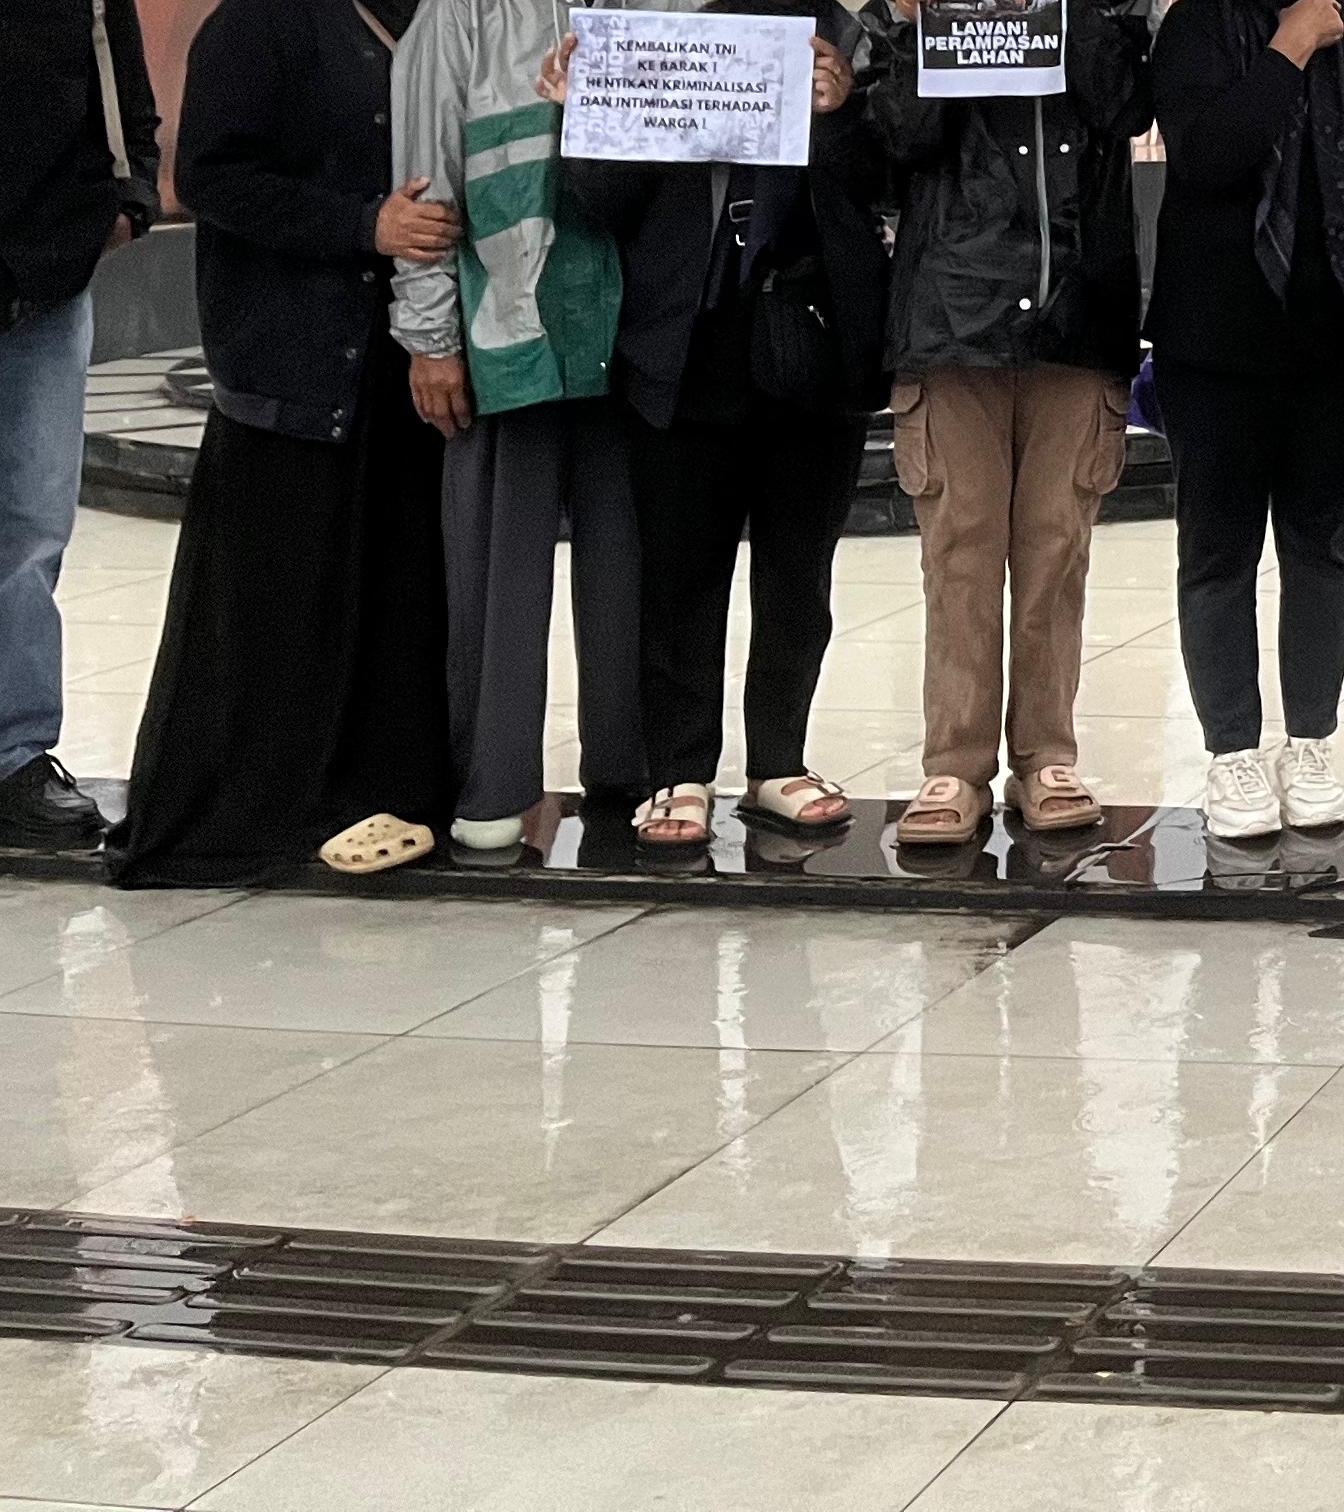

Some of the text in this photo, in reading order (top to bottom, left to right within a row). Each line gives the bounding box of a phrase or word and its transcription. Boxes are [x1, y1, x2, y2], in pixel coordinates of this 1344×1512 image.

[951, 21, 1028, 36] LAWAN!
[616, 40, 737, 55] KEMBALIKAN TNI
[925, 35, 1058, 51] PERAMPASAN
[957, 50, 1025, 65] LAHAN
[637, 60, 656, 72] KE
[660, 60, 708, 73] BARAK
[585, 76, 768, 94] HENTIKAN KRIMINALISASI
[579, 96, 774, 112] DAN INTIMIDASI TERHADAP
[643, 116, 699, 130] WARGA
